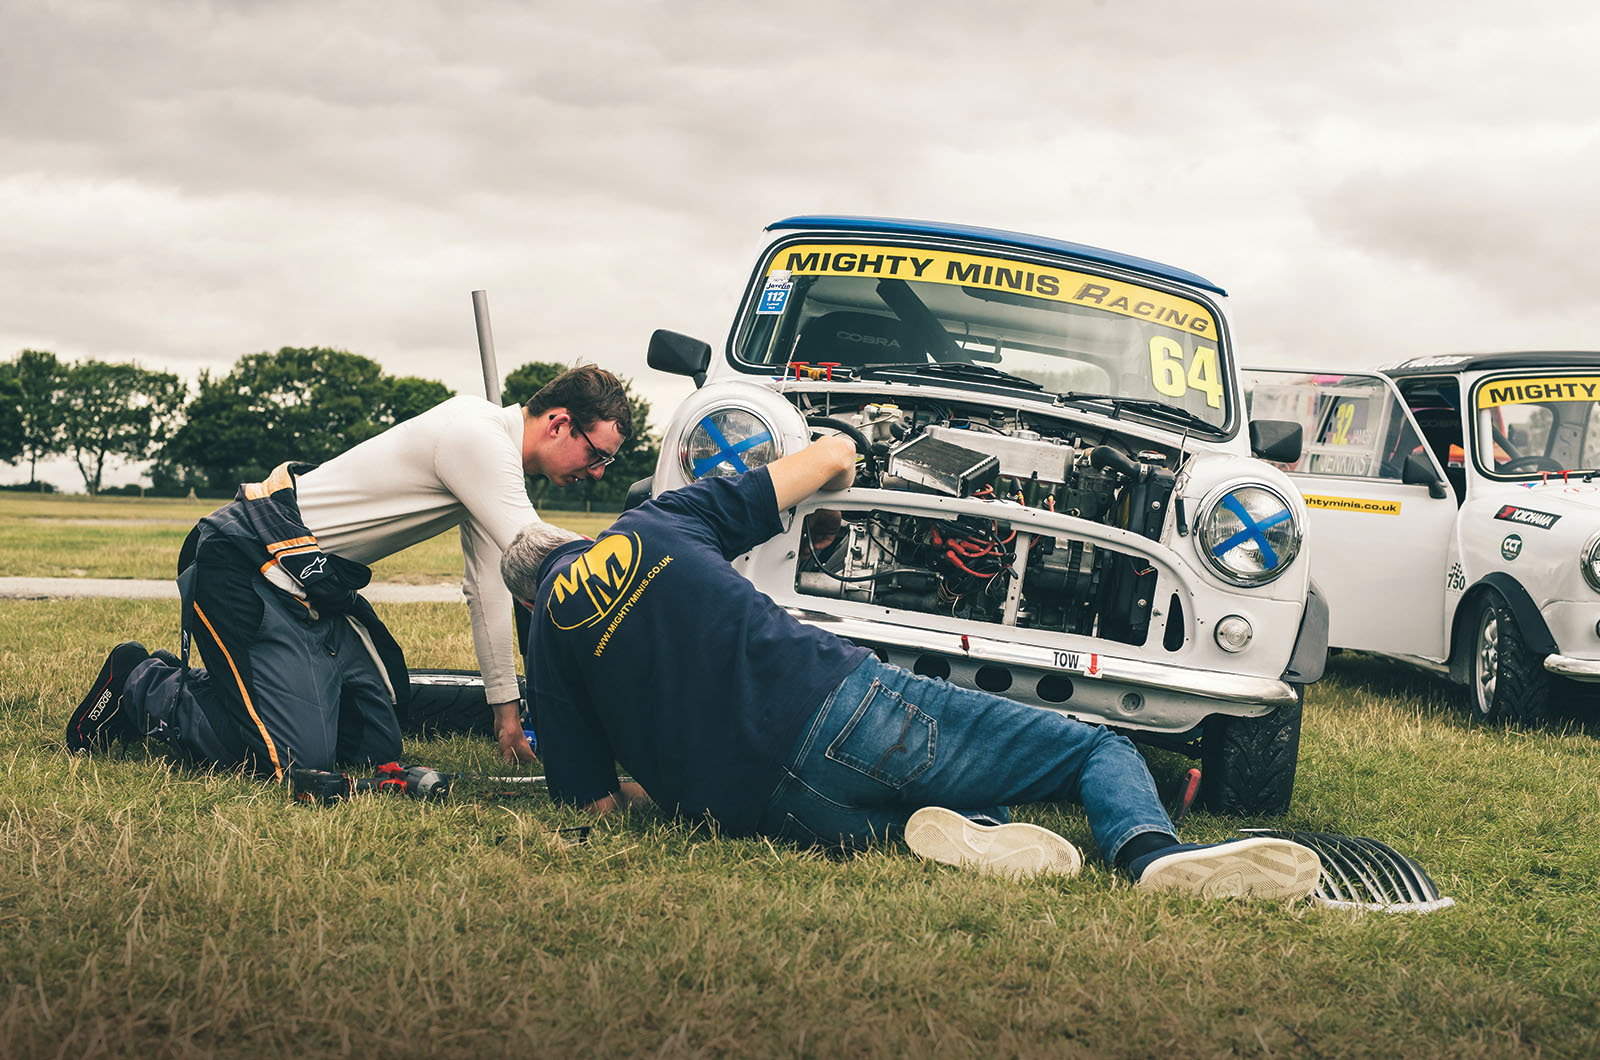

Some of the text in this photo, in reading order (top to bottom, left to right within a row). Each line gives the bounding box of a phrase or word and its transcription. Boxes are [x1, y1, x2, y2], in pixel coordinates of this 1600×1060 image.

[785, 252, 934, 277] MIGHTY
[945, 260, 1060, 296] MINIS
[767, 292, 785, 302] 112
[836, 330, 901, 348] COBRA
[1149, 335, 1224, 409] 64
[1489, 383, 1597, 404] MIGHTY
[1332, 403, 1355, 445] 32
[1503, 538, 1522, 552] CCT
[1447, 573, 1466, 591] 750
[593, 555, 674, 657] WWW.MIGHTYMINIS.CO.UK
[1053, 651, 1080, 669] TOW
[88, 688, 112, 721] sparco
